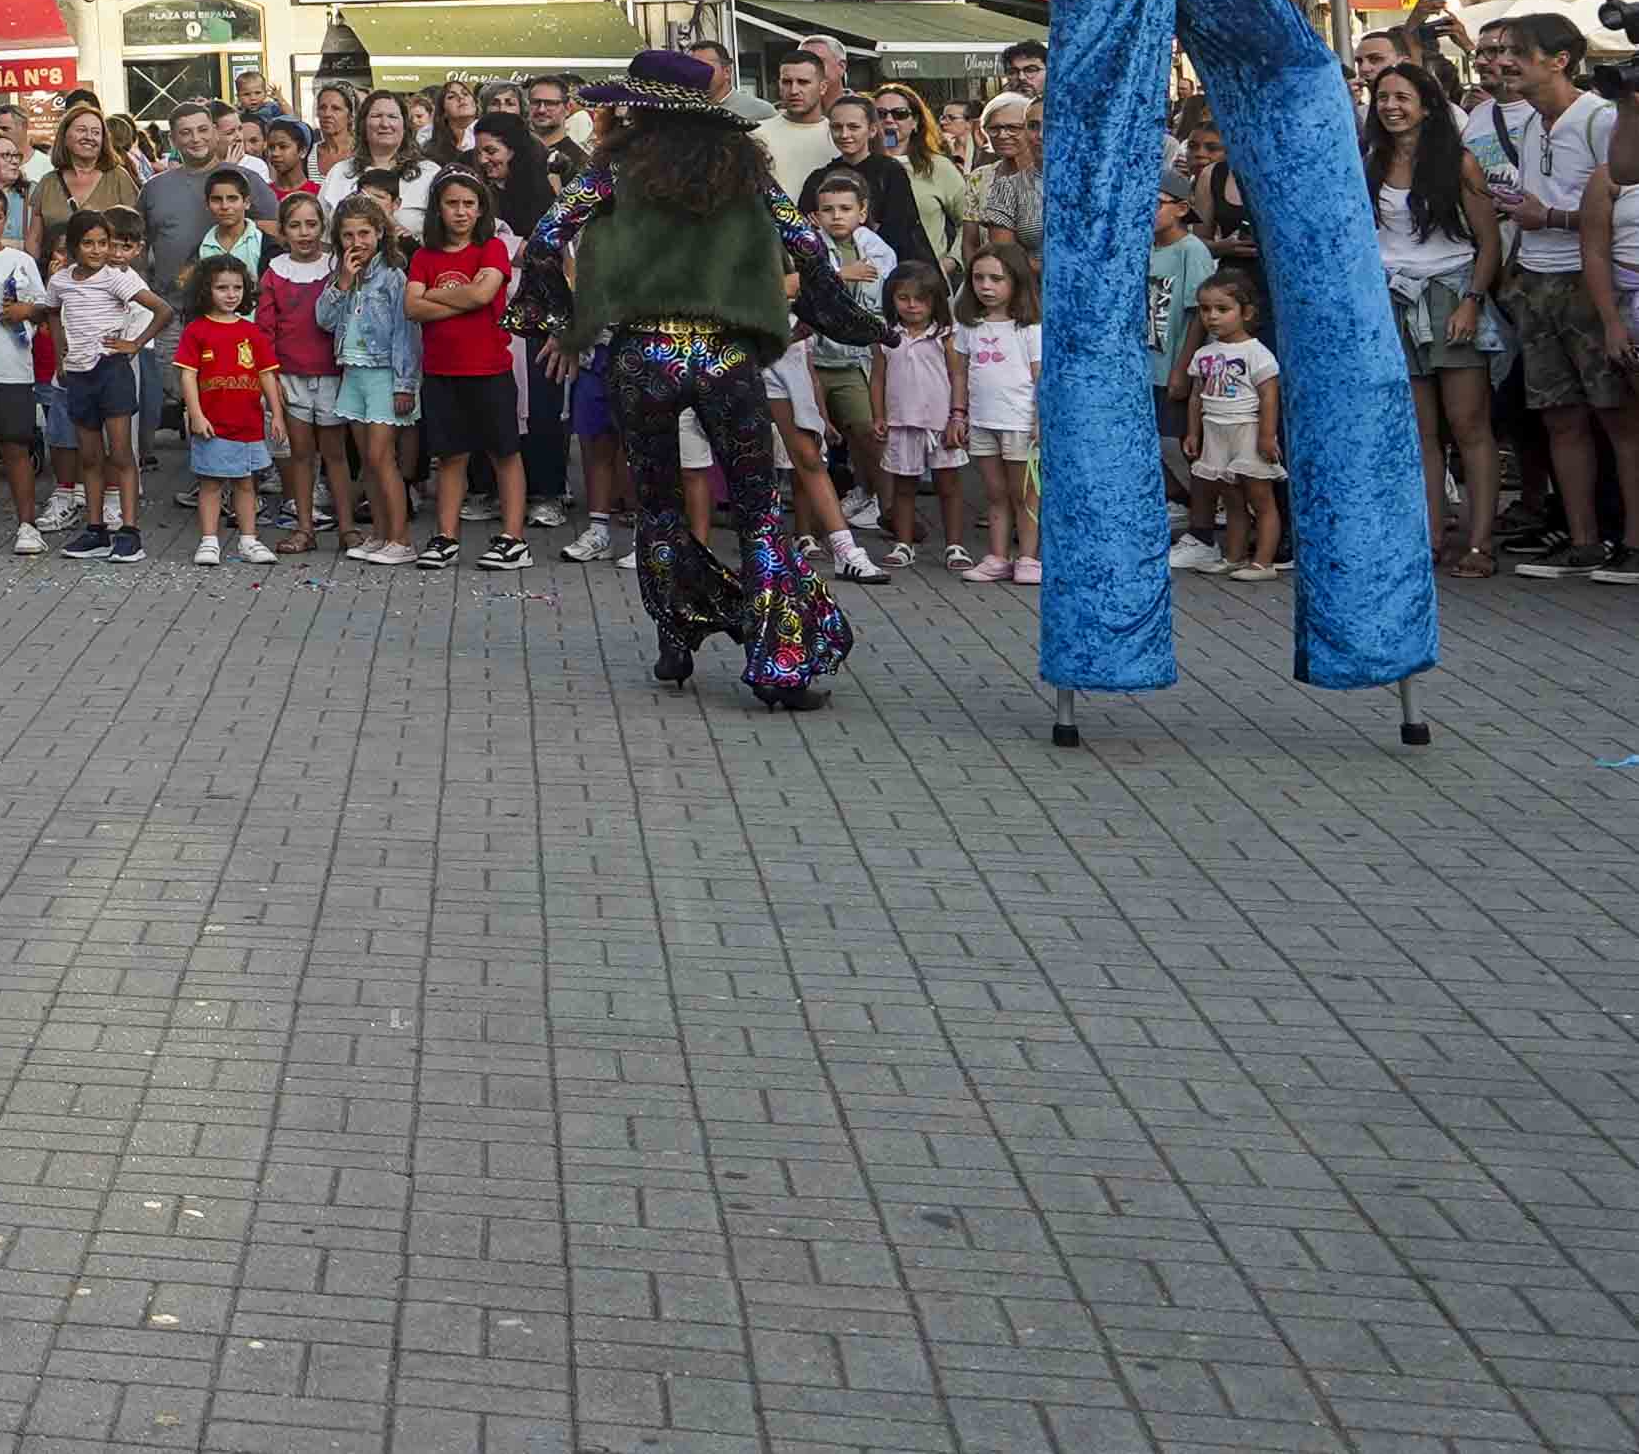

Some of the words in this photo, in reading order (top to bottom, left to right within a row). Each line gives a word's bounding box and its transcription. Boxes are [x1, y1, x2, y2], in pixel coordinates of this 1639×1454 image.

[149, 11, 180, 19] PLAZA
[182, 11, 196, 19] DE
[198, 10, 237, 19] ESPAÑA
